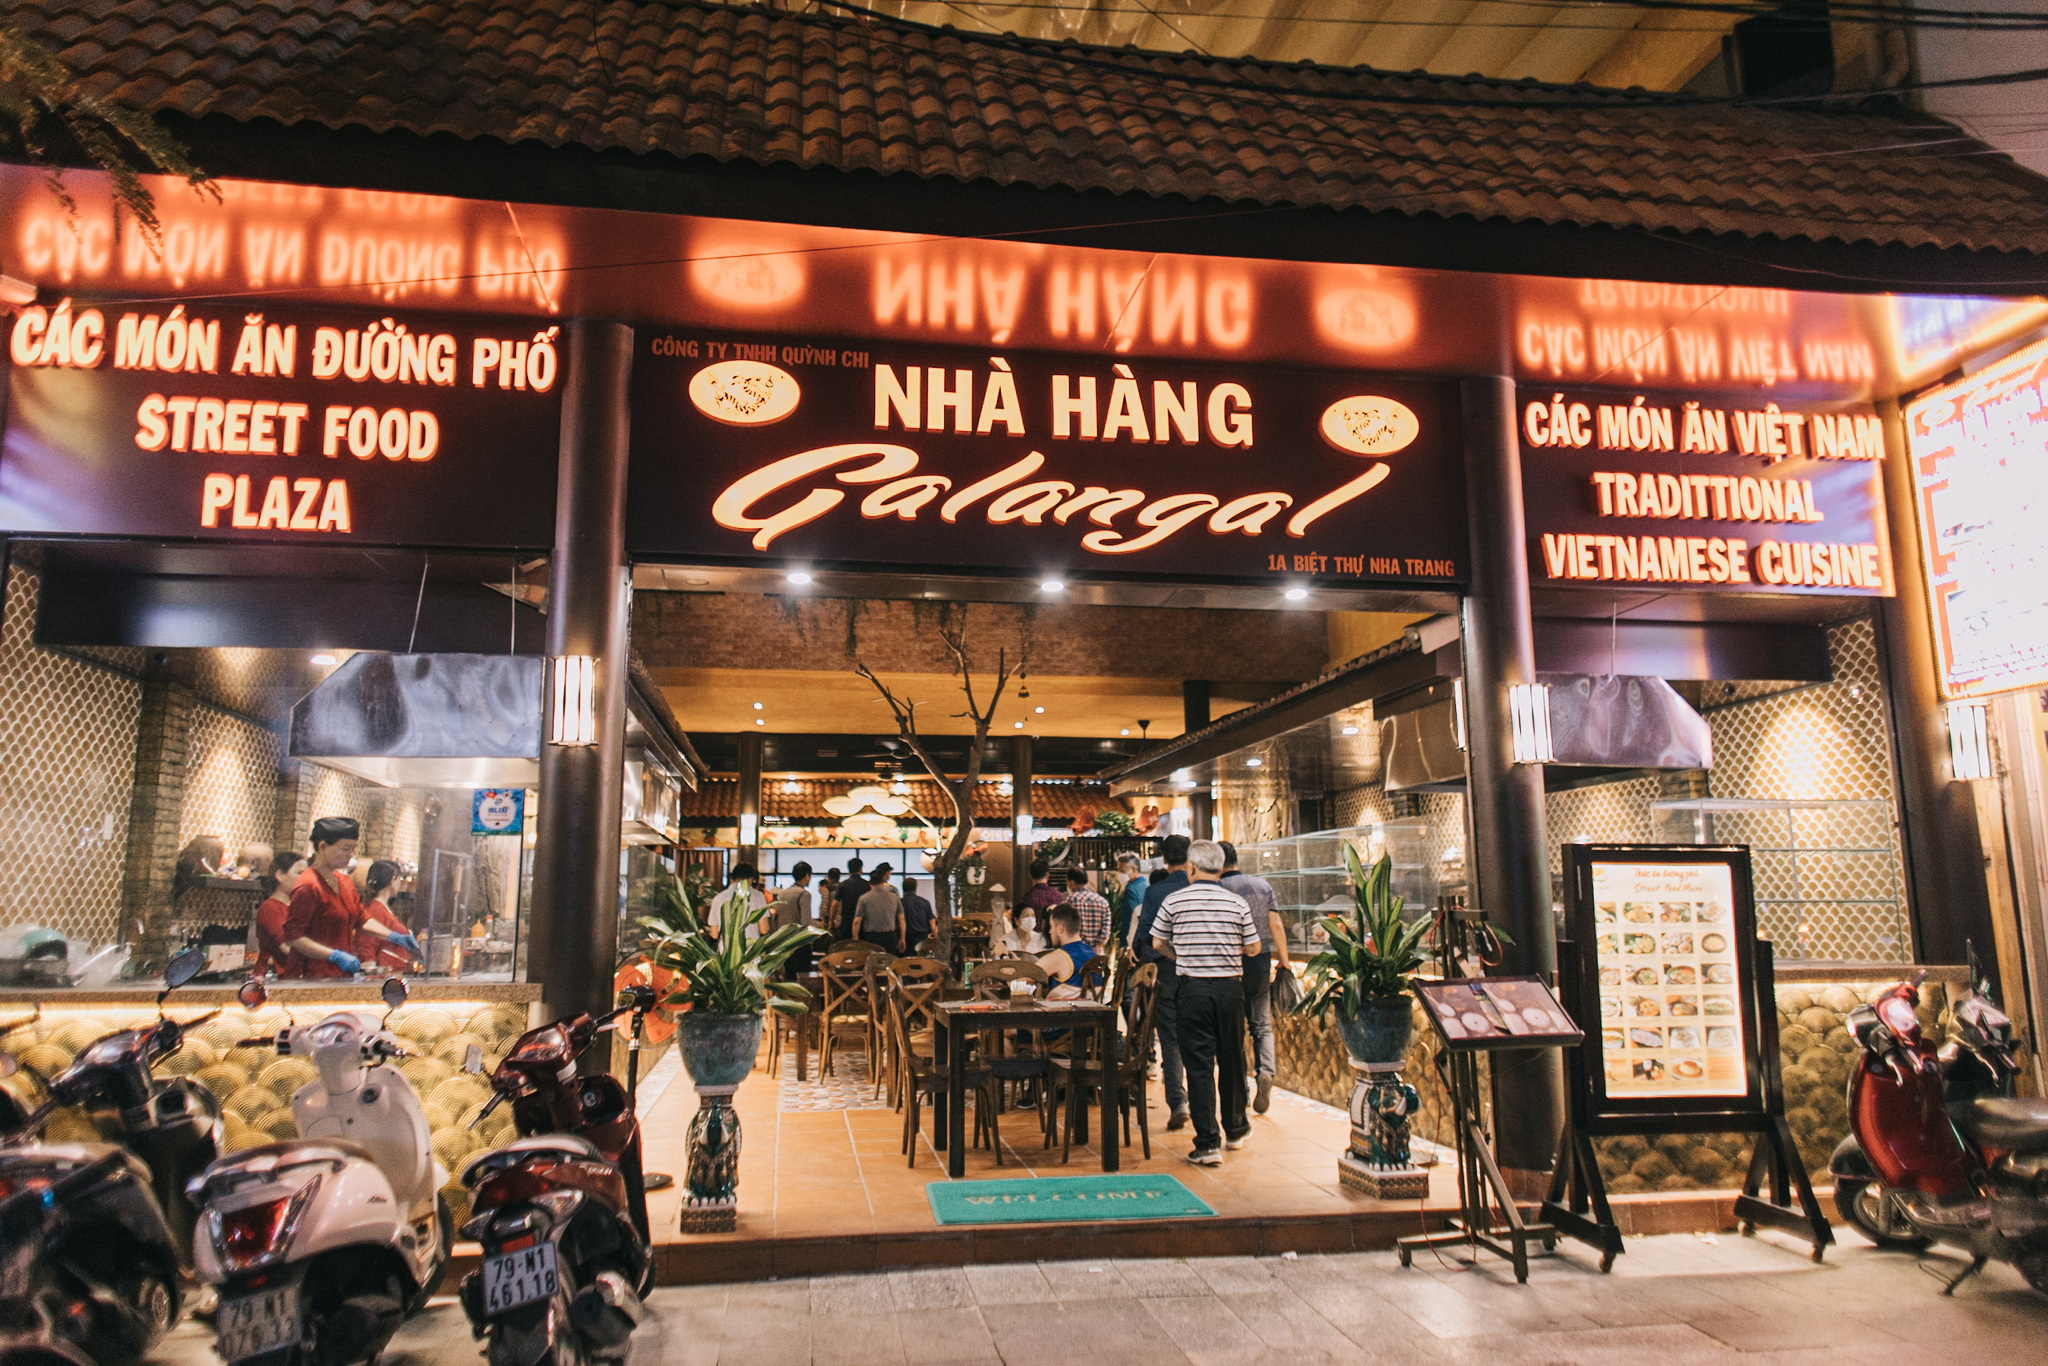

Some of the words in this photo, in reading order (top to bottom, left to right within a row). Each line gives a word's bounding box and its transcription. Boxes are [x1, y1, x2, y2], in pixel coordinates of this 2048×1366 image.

[11, 297, 104, 367] CÁC
[114, 305, 220, 374] MÓN
[232, 314, 296, 377] ĂN
[312, 317, 456, 386] ĐƯỜNG
[471, 325, 559, 393] PHỐ
[651, 335, 698, 358] CÔNG
[706, 341, 728, 359] TY
[733, 343, 777, 362] TNHH
[781, 344, 836, 366] QUỲNH
[841, 351, 869, 368] CHI
[134, 393, 307, 456] STREET
[322, 406, 439, 462] FOOD
[874, 356, 1026, 438] NHÀ
[1051, 363, 1253, 449] HÀNG
[1523, 393, 1592, 449] CÁC
[1598, 396, 1675, 452] MÓN
[1679, 402, 1728, 455] ĂN
[1733, 403, 1804, 465] VIỆT
[1812, 414, 1886, 461] NAM
[201, 474, 351, 533] PLAZA
[712, 443, 1391, 554] Galangal
[1592, 471, 1825, 524] TRADITTIONAL
[1268, 554, 1287, 571] 1A
[1294, 551, 1328, 575] BIỆT
[1334, 554, 1364, 577] THỰ
[1370, 558, 1401, 575] NHA
[1404, 559, 1455, 577] TRANG
[1542, 533, 1750, 584] VIETNAMESE
[1755, 540, 1882, 588] CUISINE
